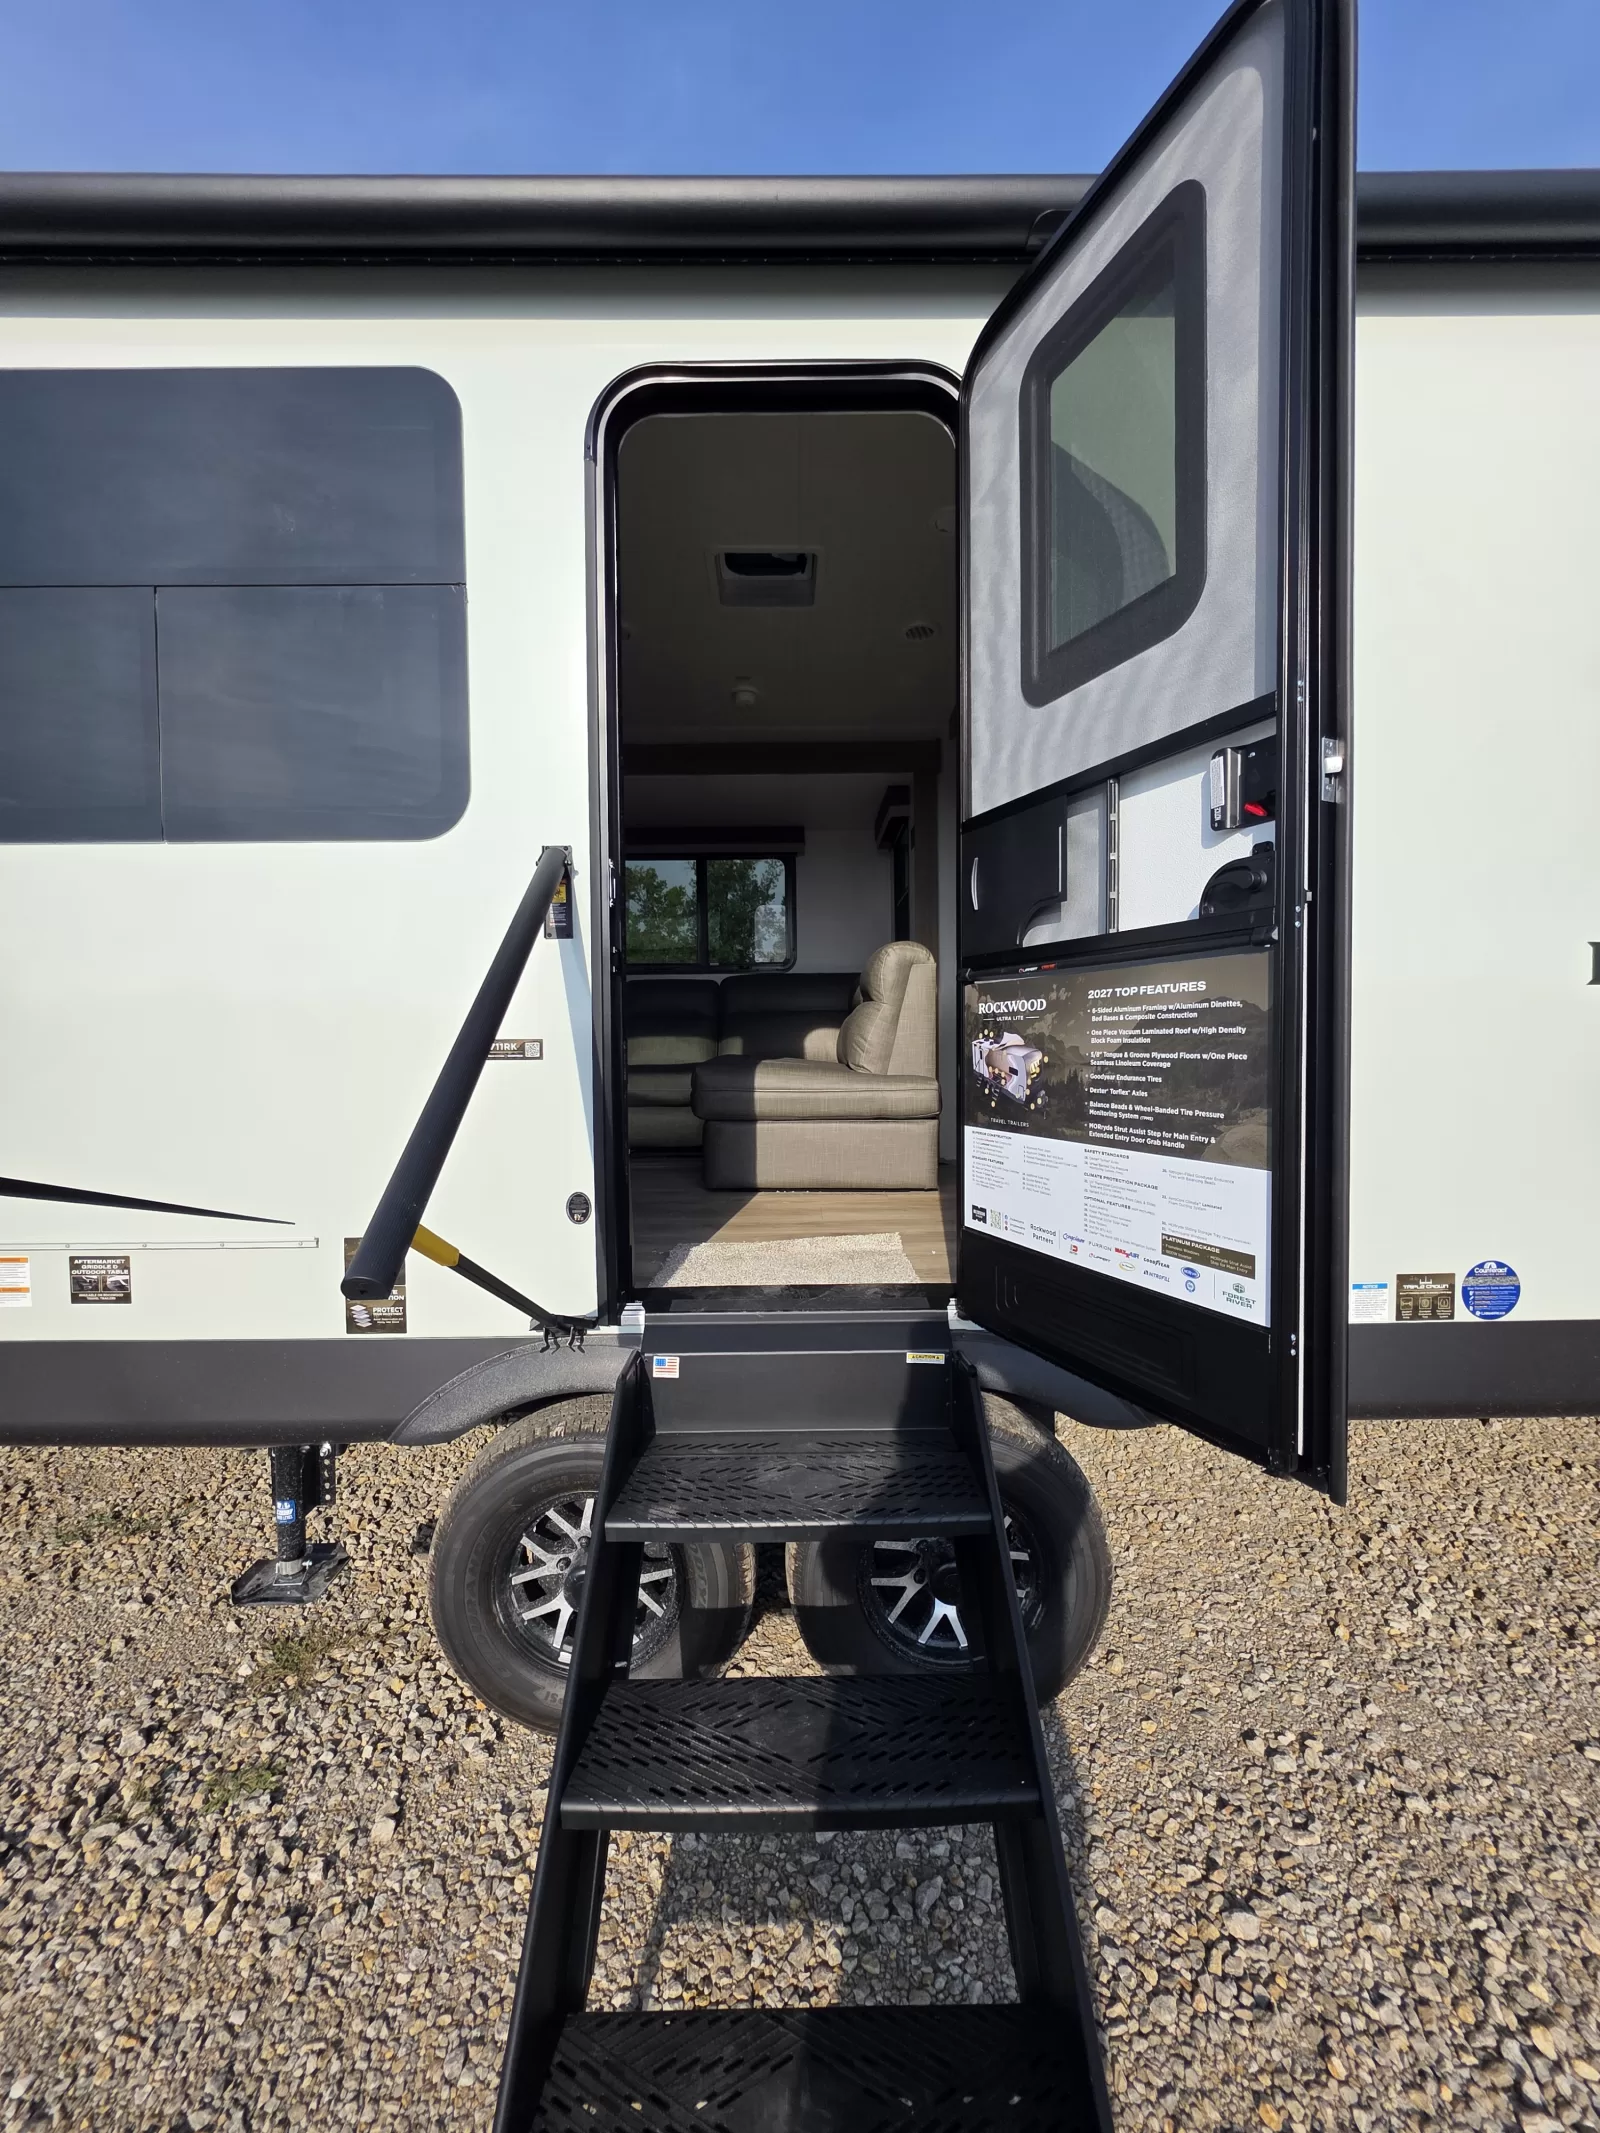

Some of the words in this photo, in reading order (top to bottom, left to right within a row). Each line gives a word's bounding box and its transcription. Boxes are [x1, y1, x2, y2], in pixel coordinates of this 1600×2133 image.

[1088, 989, 1112, 999] 2027
[1115, 986, 1138, 997] TOP
[1140, 981, 1206, 995] FEATURES
[978, 999, 1046, 1014] ROCKWOOD
[1143, 1004, 1167, 1012] Framing
[1168, 1002, 1209, 1010] w/Aluminum
[1211, 1000, 1243, 1008] Dinettes,
[1125, 1013, 1156, 1021] Composite
[1192, 1026, 1217, 1035] w/High
[1218, 1026, 1246, 1035] Density
[1089, 1109, 1117, 1118] Monitoring
[1134, 1104, 1179, 1115] Wheel-Banded
[1180, 1108, 1193, 1117] Tire
[1195, 1110, 1225, 1119] Pressure
[1089, 1131, 1114, 1140] Extended
[1115, 1134, 1130, 1143] Entry
[1131, 1136, 1145, 1144] Door
[1146, 1138, 1161, 1146] Grab
[1162, 1140, 1185, 1149] Handle
[1114, 1124, 1128, 1133] Strut
[1129, 1127, 1146, 1135] Assist
[1147, 1129, 1161, 1138] Step
[1174, 1132, 1189, 1141] Main
[1190, 1134, 1209, 1144] Entry
[1103, 1176, 1133, 1186] PROTECTION
[1134, 1182, 1158, 1190] PACKAGE
[1107, 1200, 1130, 1210] FEATURES
[1030, 1224, 1056, 1237] Rockwood
[1032, 1233, 1054, 1244] Partners
[1163, 1235, 1190, 1246] PLATINUM
[1192, 1242, 1220, 1253] PACKAGE
[1222, 1291, 1256, 1305] FOREST
[1226, 1297, 1252, 1309] RIVER
